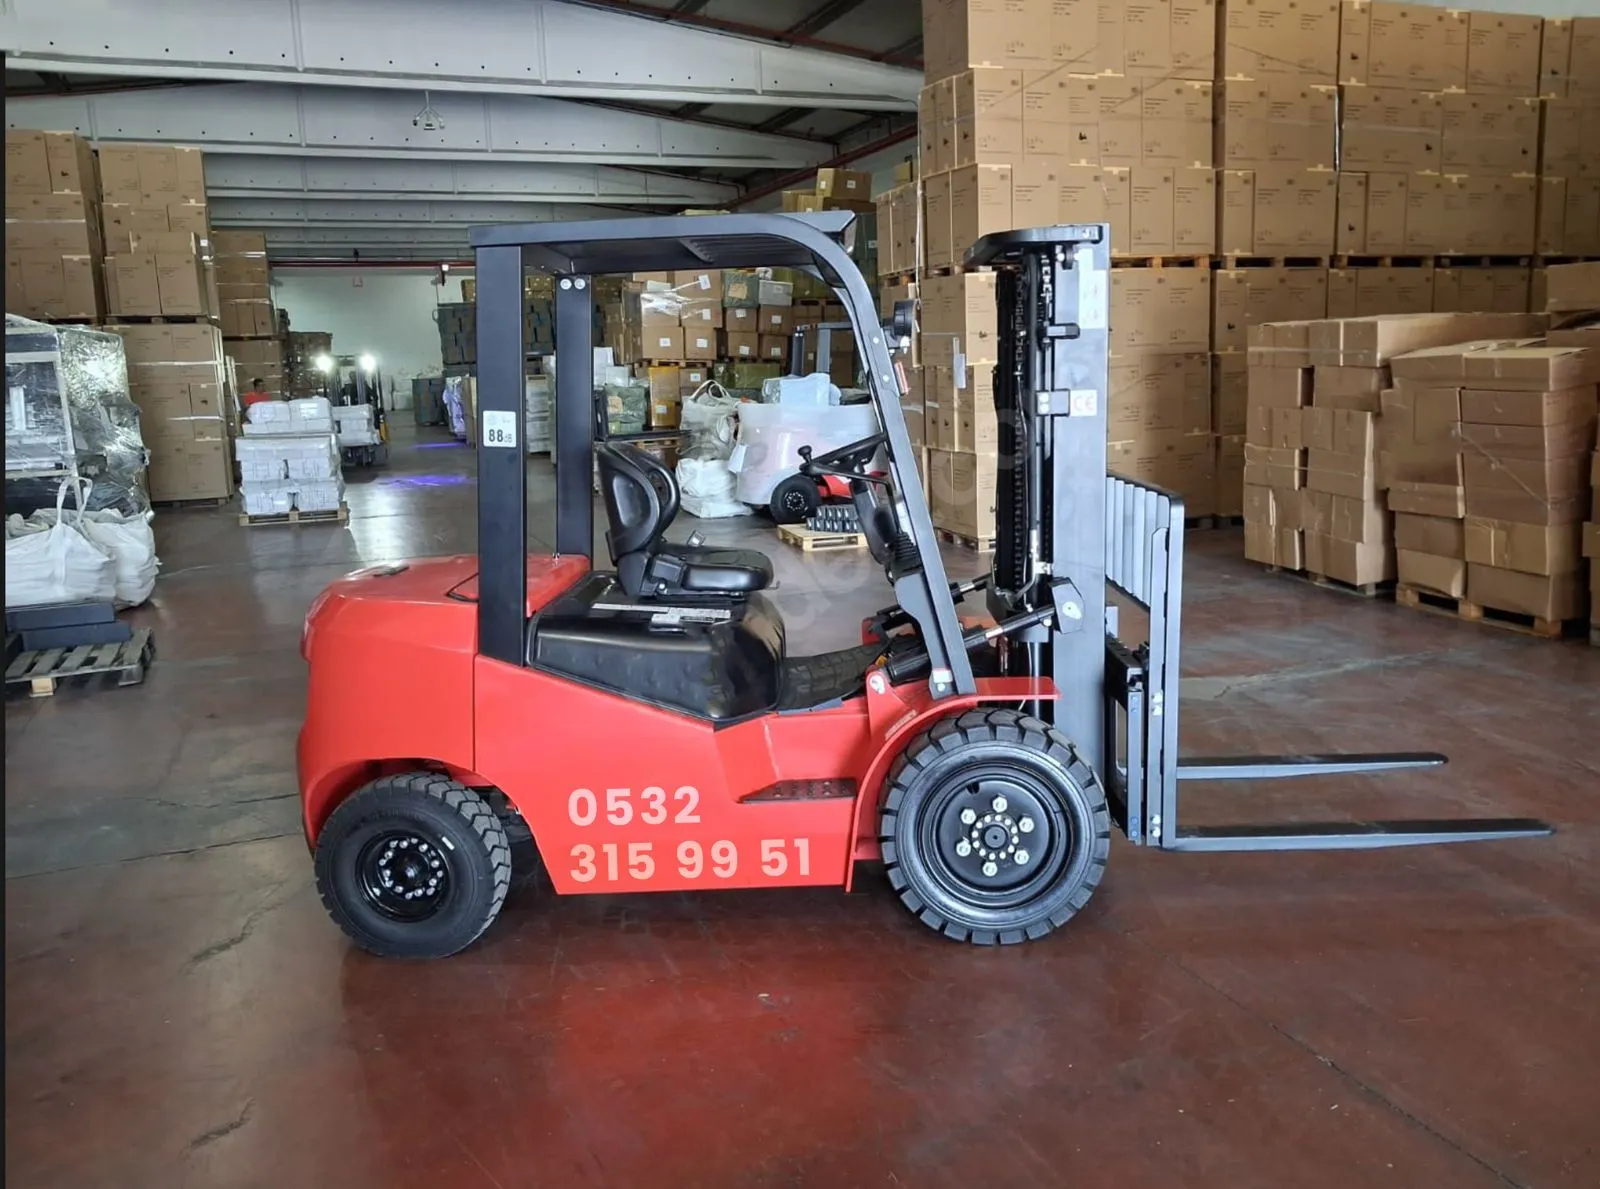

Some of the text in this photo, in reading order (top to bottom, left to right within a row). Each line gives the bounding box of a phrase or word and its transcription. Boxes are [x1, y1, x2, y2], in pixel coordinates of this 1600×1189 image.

[1073, 394, 1095, 411] CE
[568, 786, 701, 826] 0532
[570, 837, 810, 883] 315 99 51
